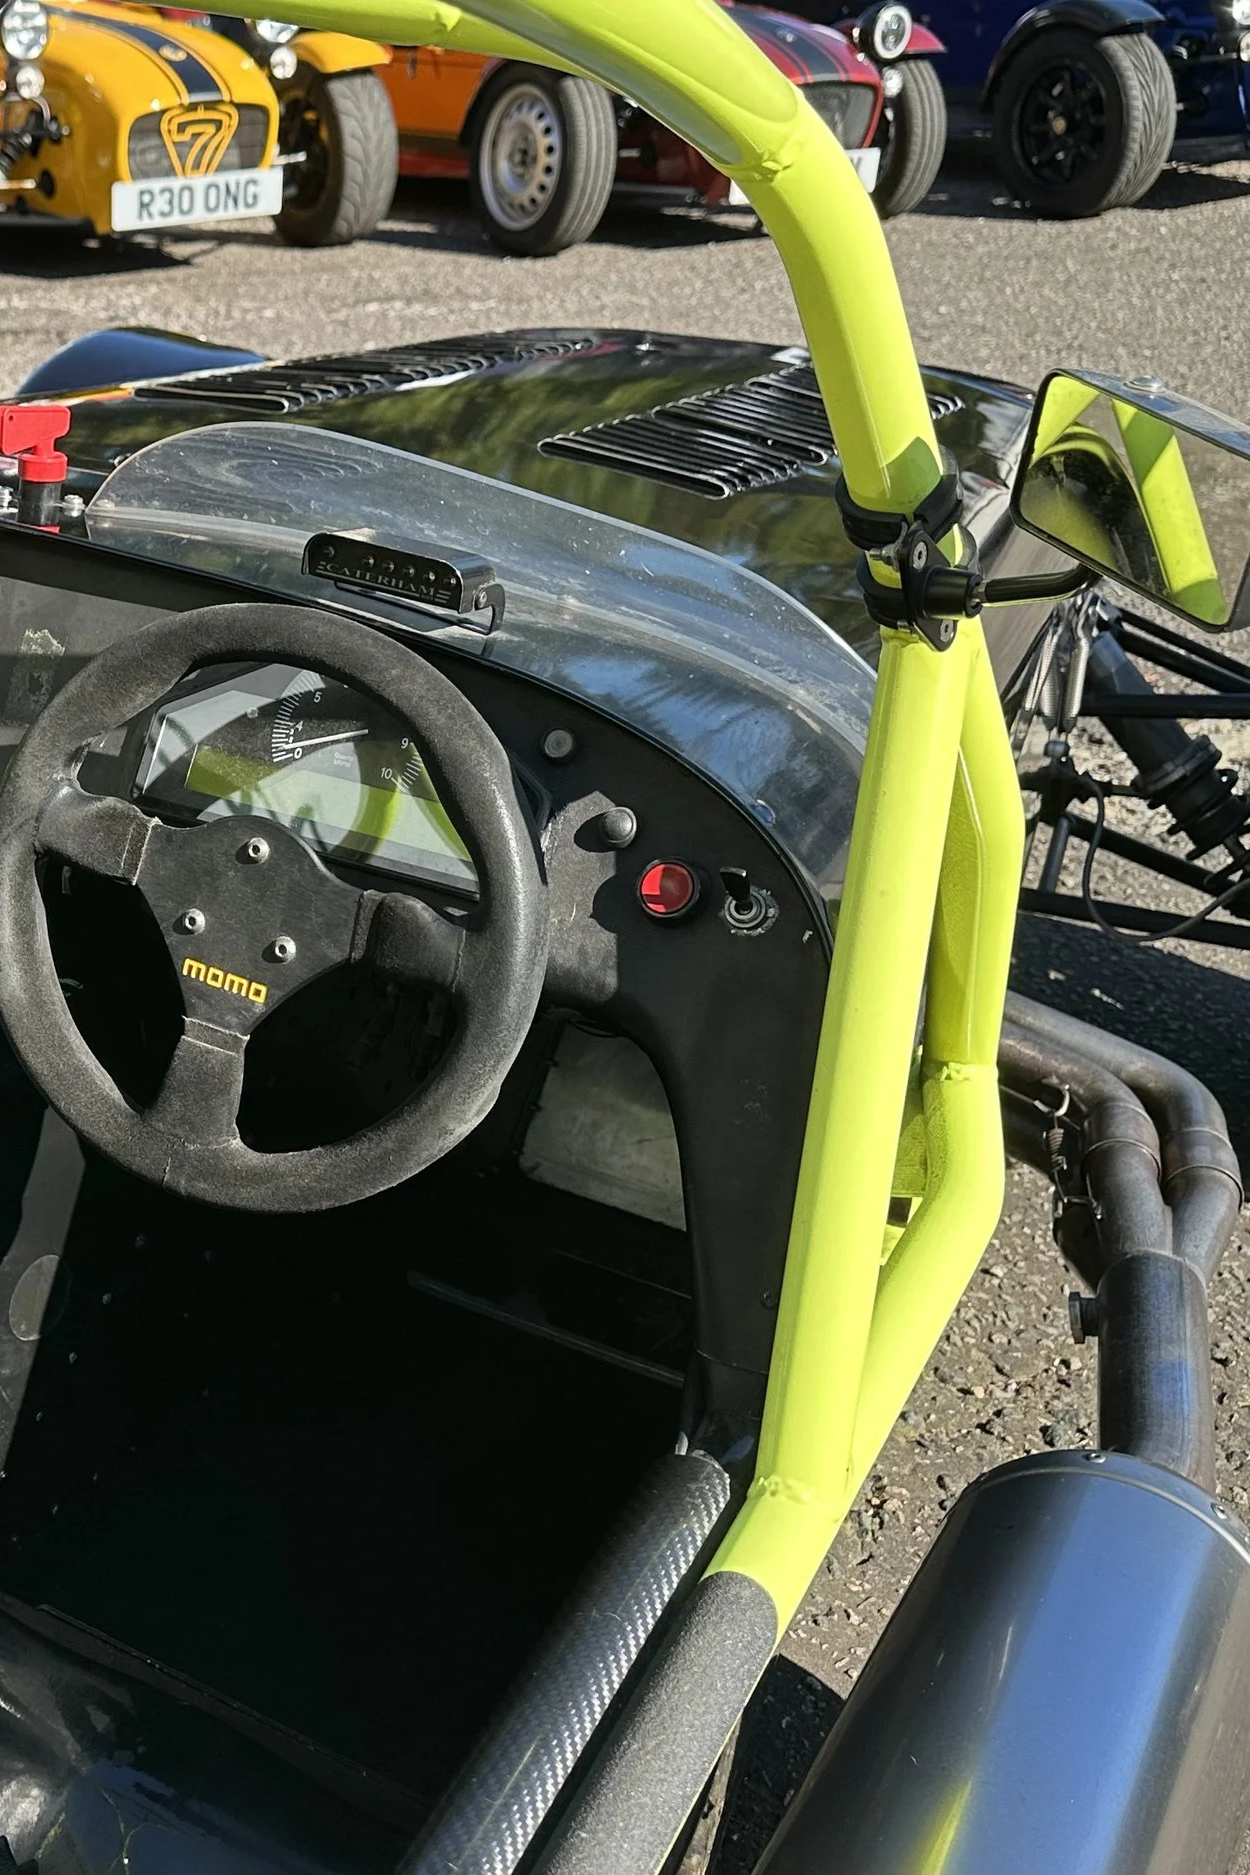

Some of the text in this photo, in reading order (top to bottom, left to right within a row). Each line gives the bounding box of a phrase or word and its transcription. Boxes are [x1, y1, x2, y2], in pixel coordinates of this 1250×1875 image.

[137, 179, 259, 221] R30 ONG
[325, 562, 436, 596] CATERHAM
[313, 691, 323, 703] 5
[295, 720, 304, 731] 4
[400, 737, 409, 749] 9
[293, 747, 303, 759] 0
[380, 766, 393, 779] 10
[182, 958, 268, 1003] momo
